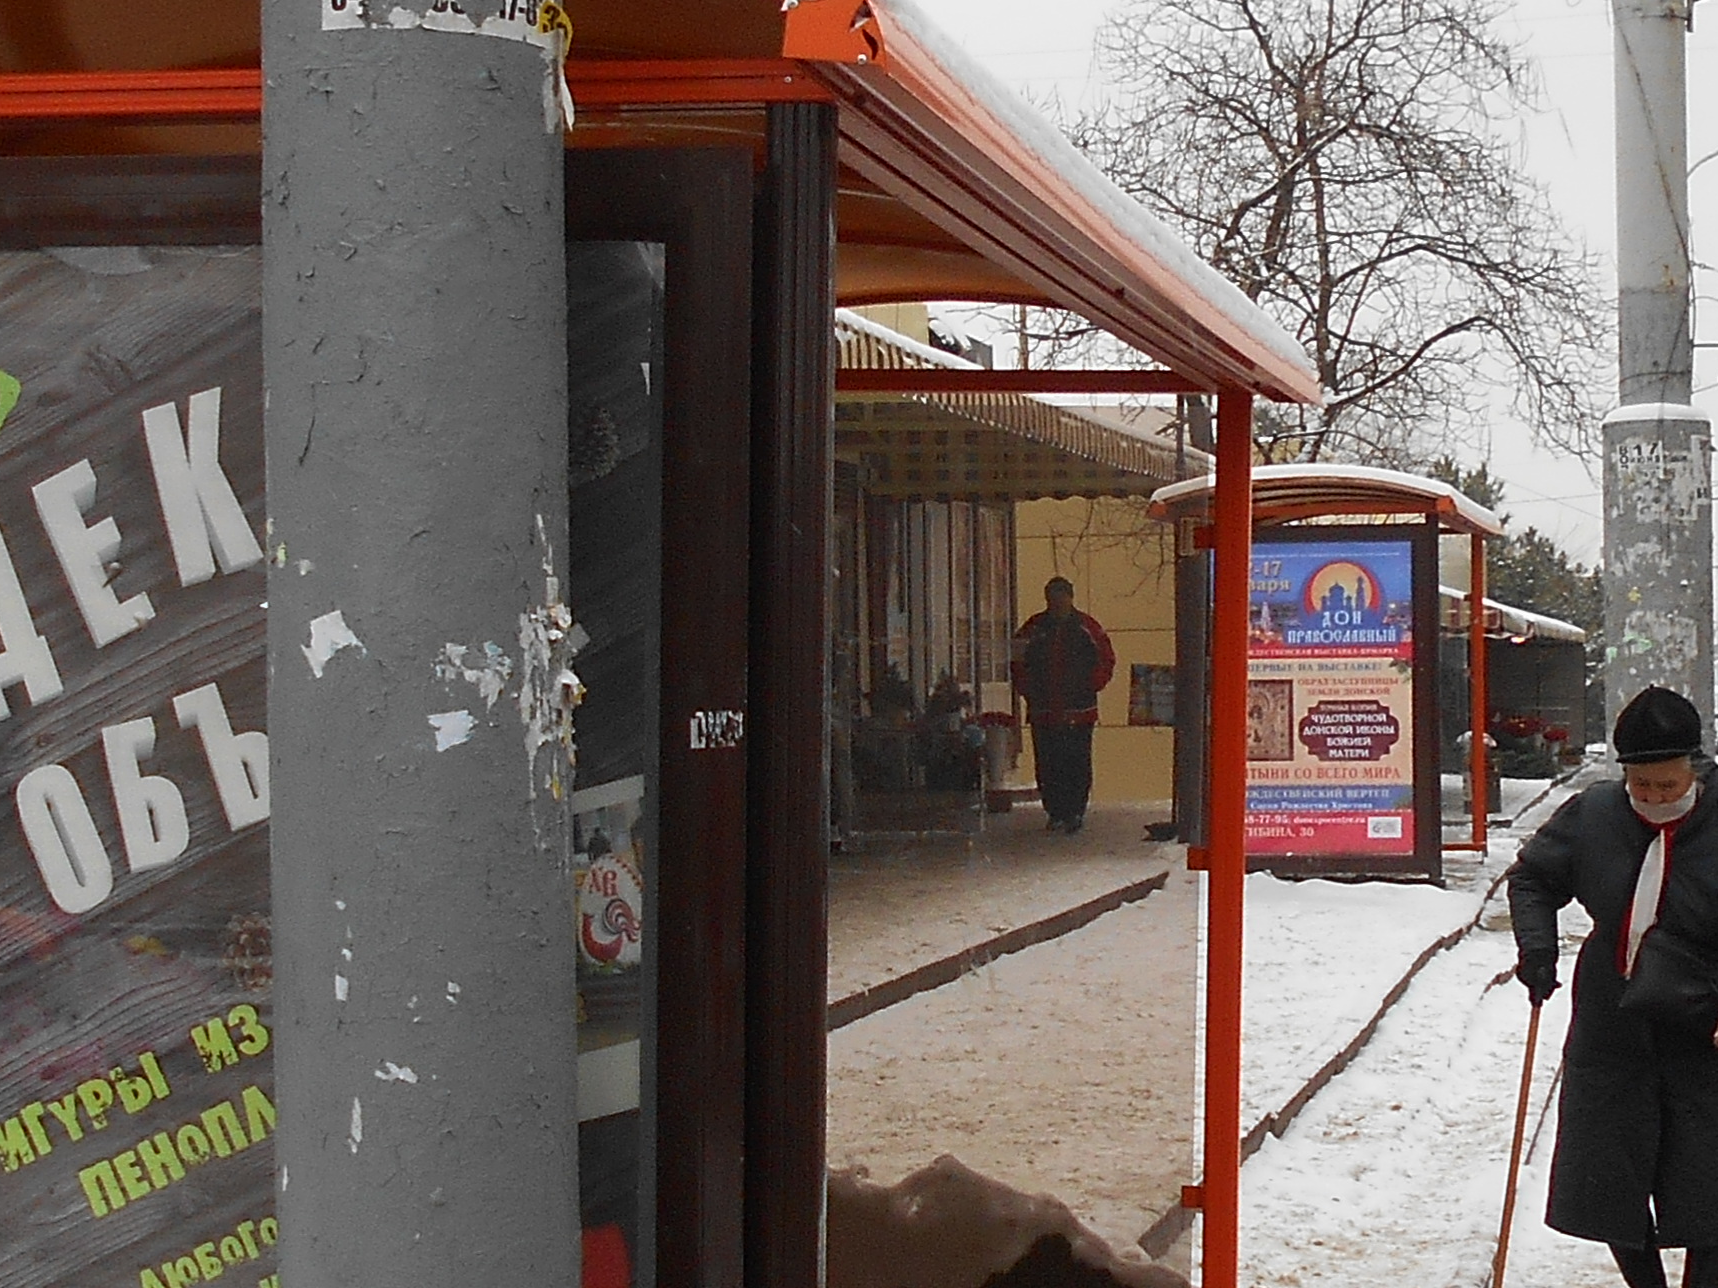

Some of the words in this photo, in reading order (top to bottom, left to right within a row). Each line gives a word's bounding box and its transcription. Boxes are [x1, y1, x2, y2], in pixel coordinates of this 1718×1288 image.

[1322, 610, 1362, 628] ДОН
[1288, 626, 1397, 644] ПРАВОСЛАВНЫЙ
[1311, 712, 1387, 723] ЧУДОТВОРНОЙ
[1302, 725, 1353, 736] ДОНСКОЙ
[1356, 725, 1396, 735] ИКОНЫ
[1326, 736, 1372, 747] БОЖИЕЙ
[1329, 749, 1370, 758] МАТЕРИ
[1294, 768, 1312, 778] СО
[1317, 768, 1358, 778] ВСЕГО
[1362, 768, 1401, 779] МИРА
[1299, 827, 1315, 836] 30
[191, 1004, 269, 1073] ИЗ
